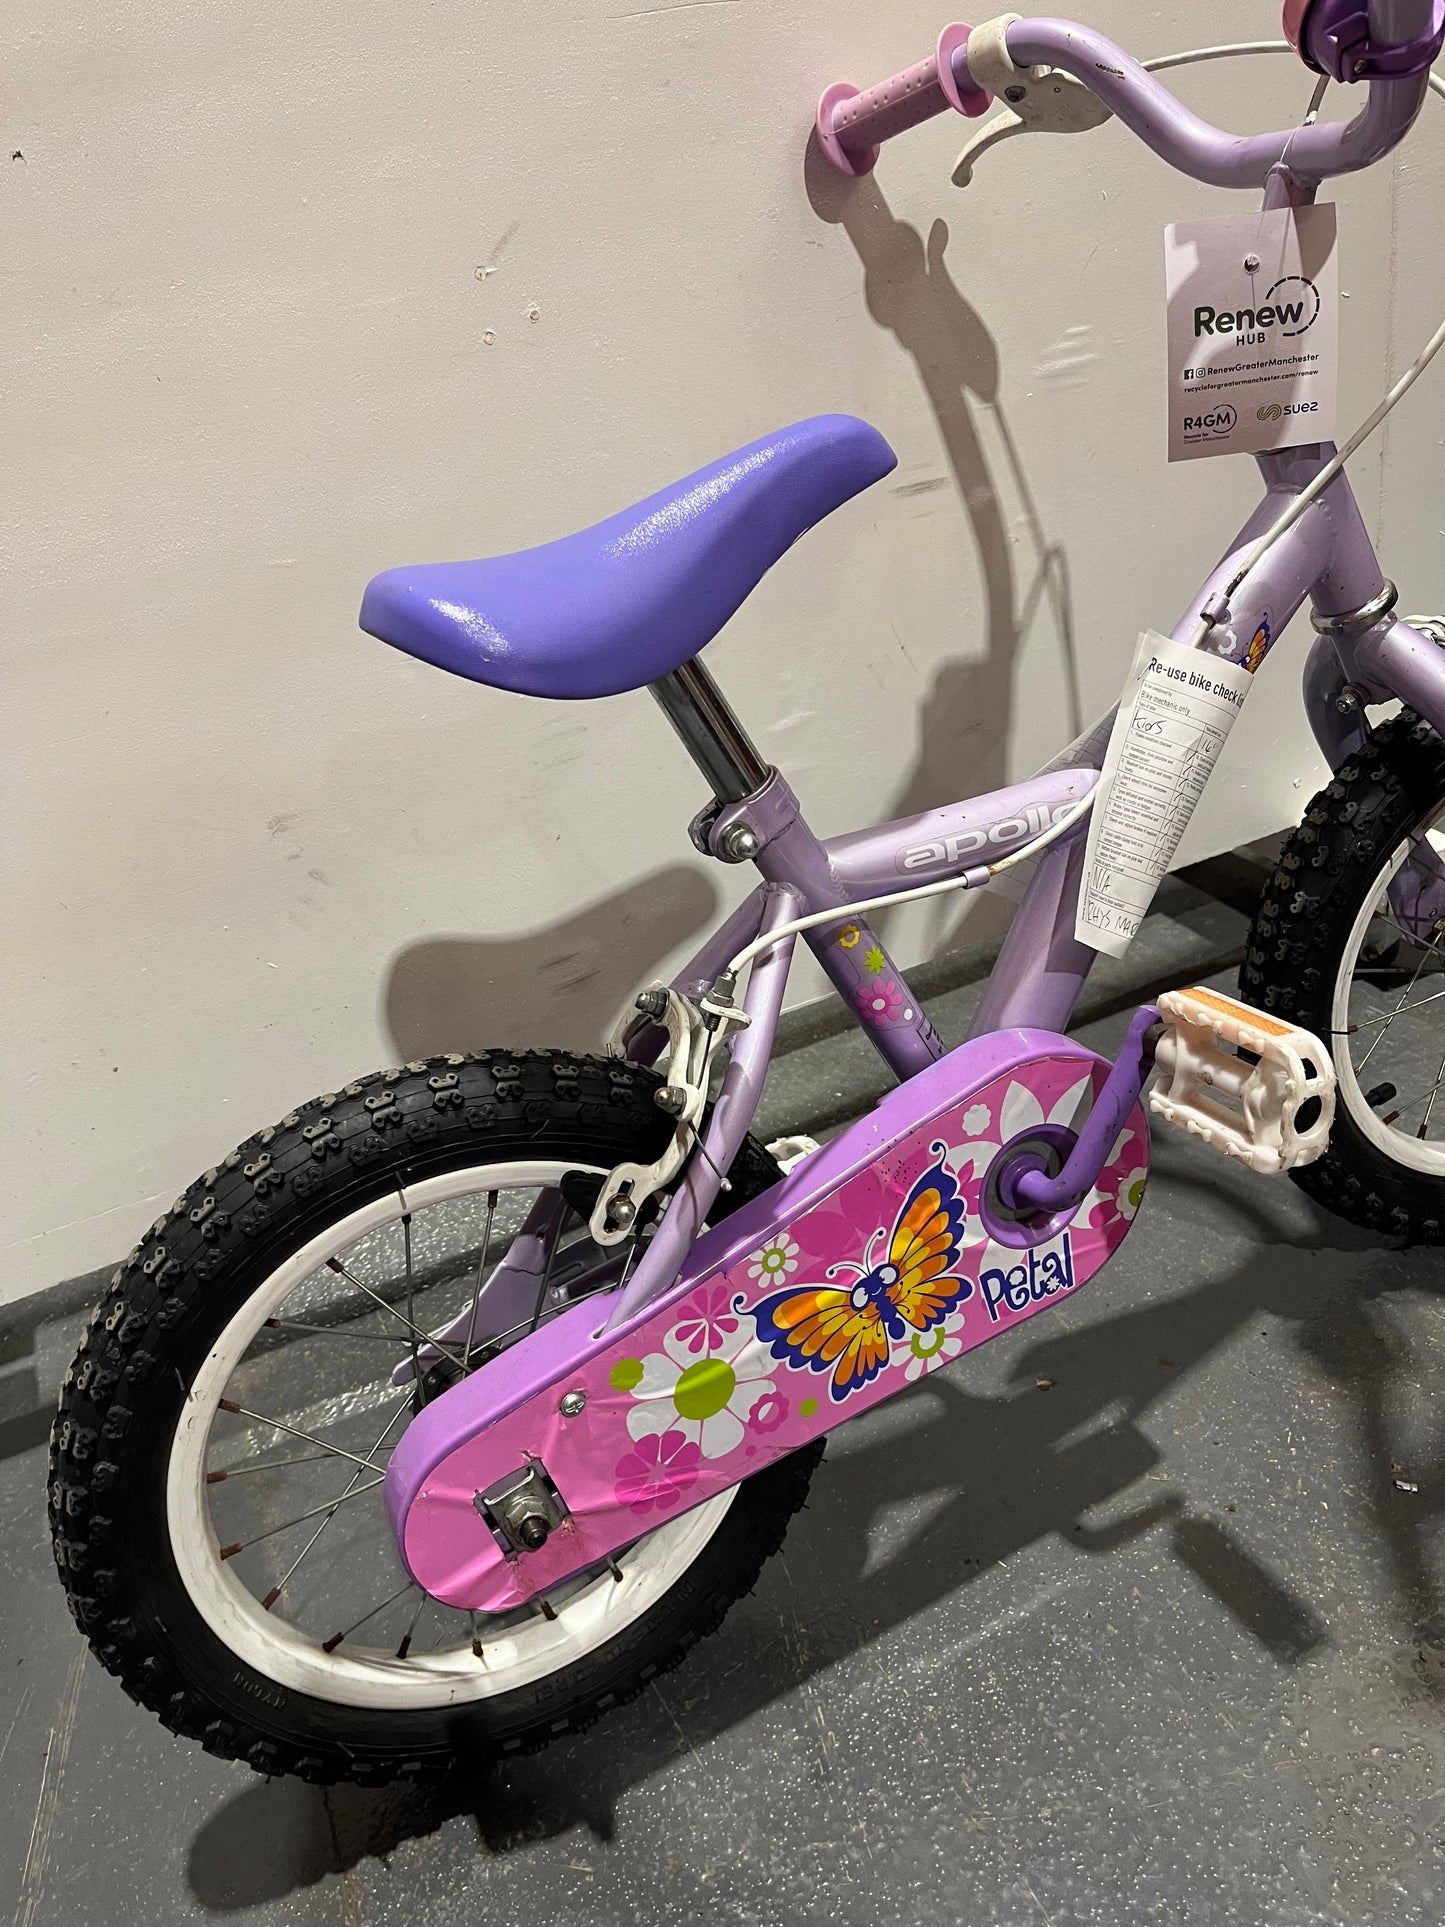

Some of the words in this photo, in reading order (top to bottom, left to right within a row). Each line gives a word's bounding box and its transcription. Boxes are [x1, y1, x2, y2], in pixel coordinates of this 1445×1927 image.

[1194, 301, 1304, 337] Renew
[1236, 332, 1266, 346] HUB
[1207, 354, 1320, 376] RenewGreaterManchester
[1184, 369, 1319, 393] recycleforgreatermanchester.com/renew
[1184, 411, 1231, 431] R4GM
[1149, 657, 1187, 682] Re-use
[1189, 671, 1212, 692] bike
[1213, 683, 1238, 704] check
[1141, 690, 1153, 701] Bike
[1153, 696, 1178, 710] mechanic
[1178, 705, 1191, 717] only
[979, 1232, 1074, 1321] Petal
